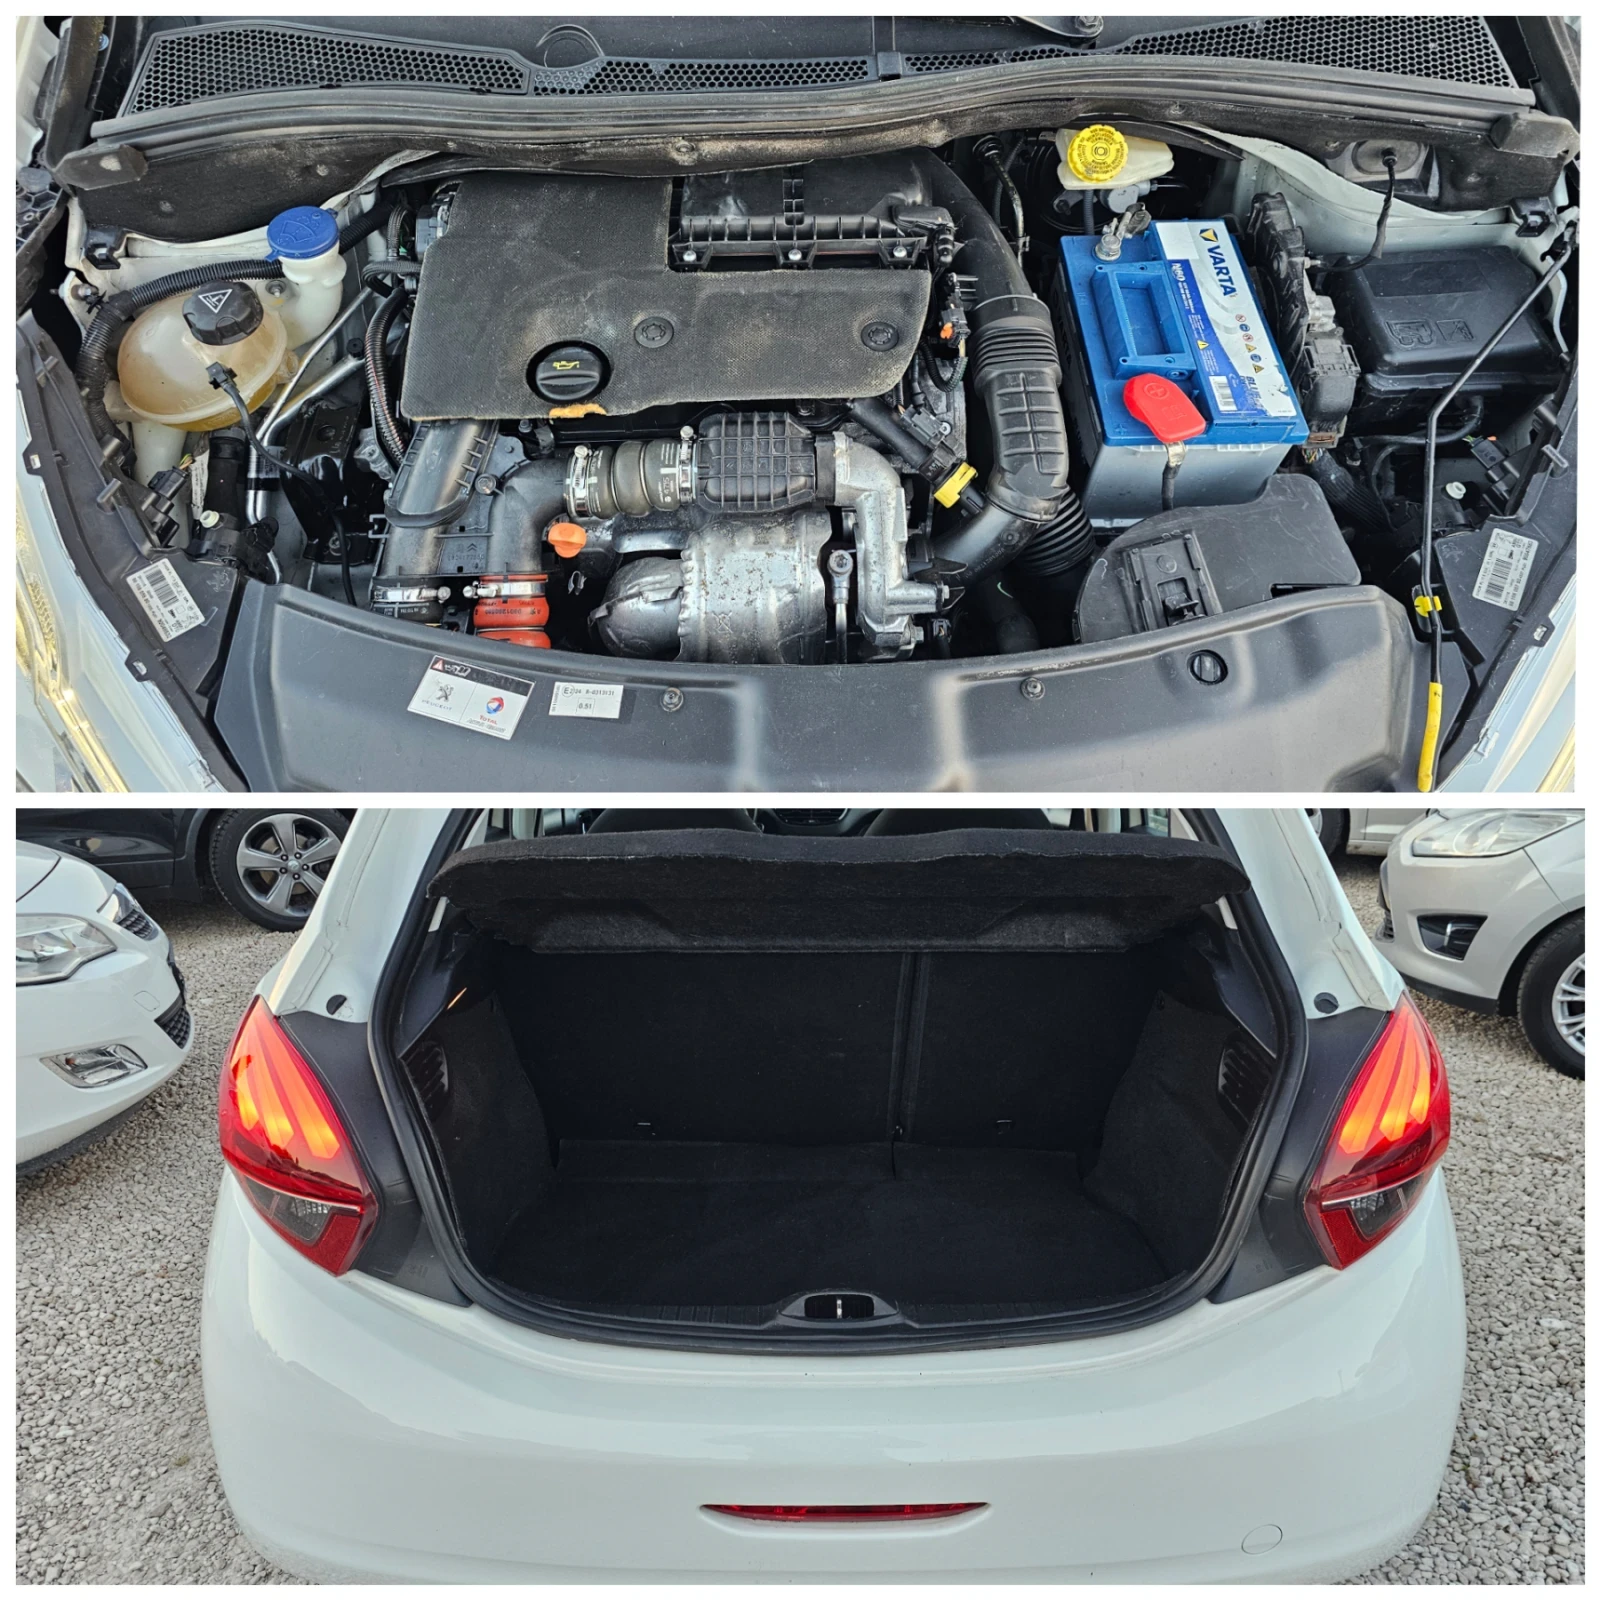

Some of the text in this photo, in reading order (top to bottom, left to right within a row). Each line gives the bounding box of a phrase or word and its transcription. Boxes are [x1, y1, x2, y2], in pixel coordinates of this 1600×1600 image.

[1171, 262, 1186, 282] N60
[1207, 245, 1236, 297] VARTA
[421, 699, 452, 711] PEUGEOT
[480, 714, 498, 725] TOTAL
